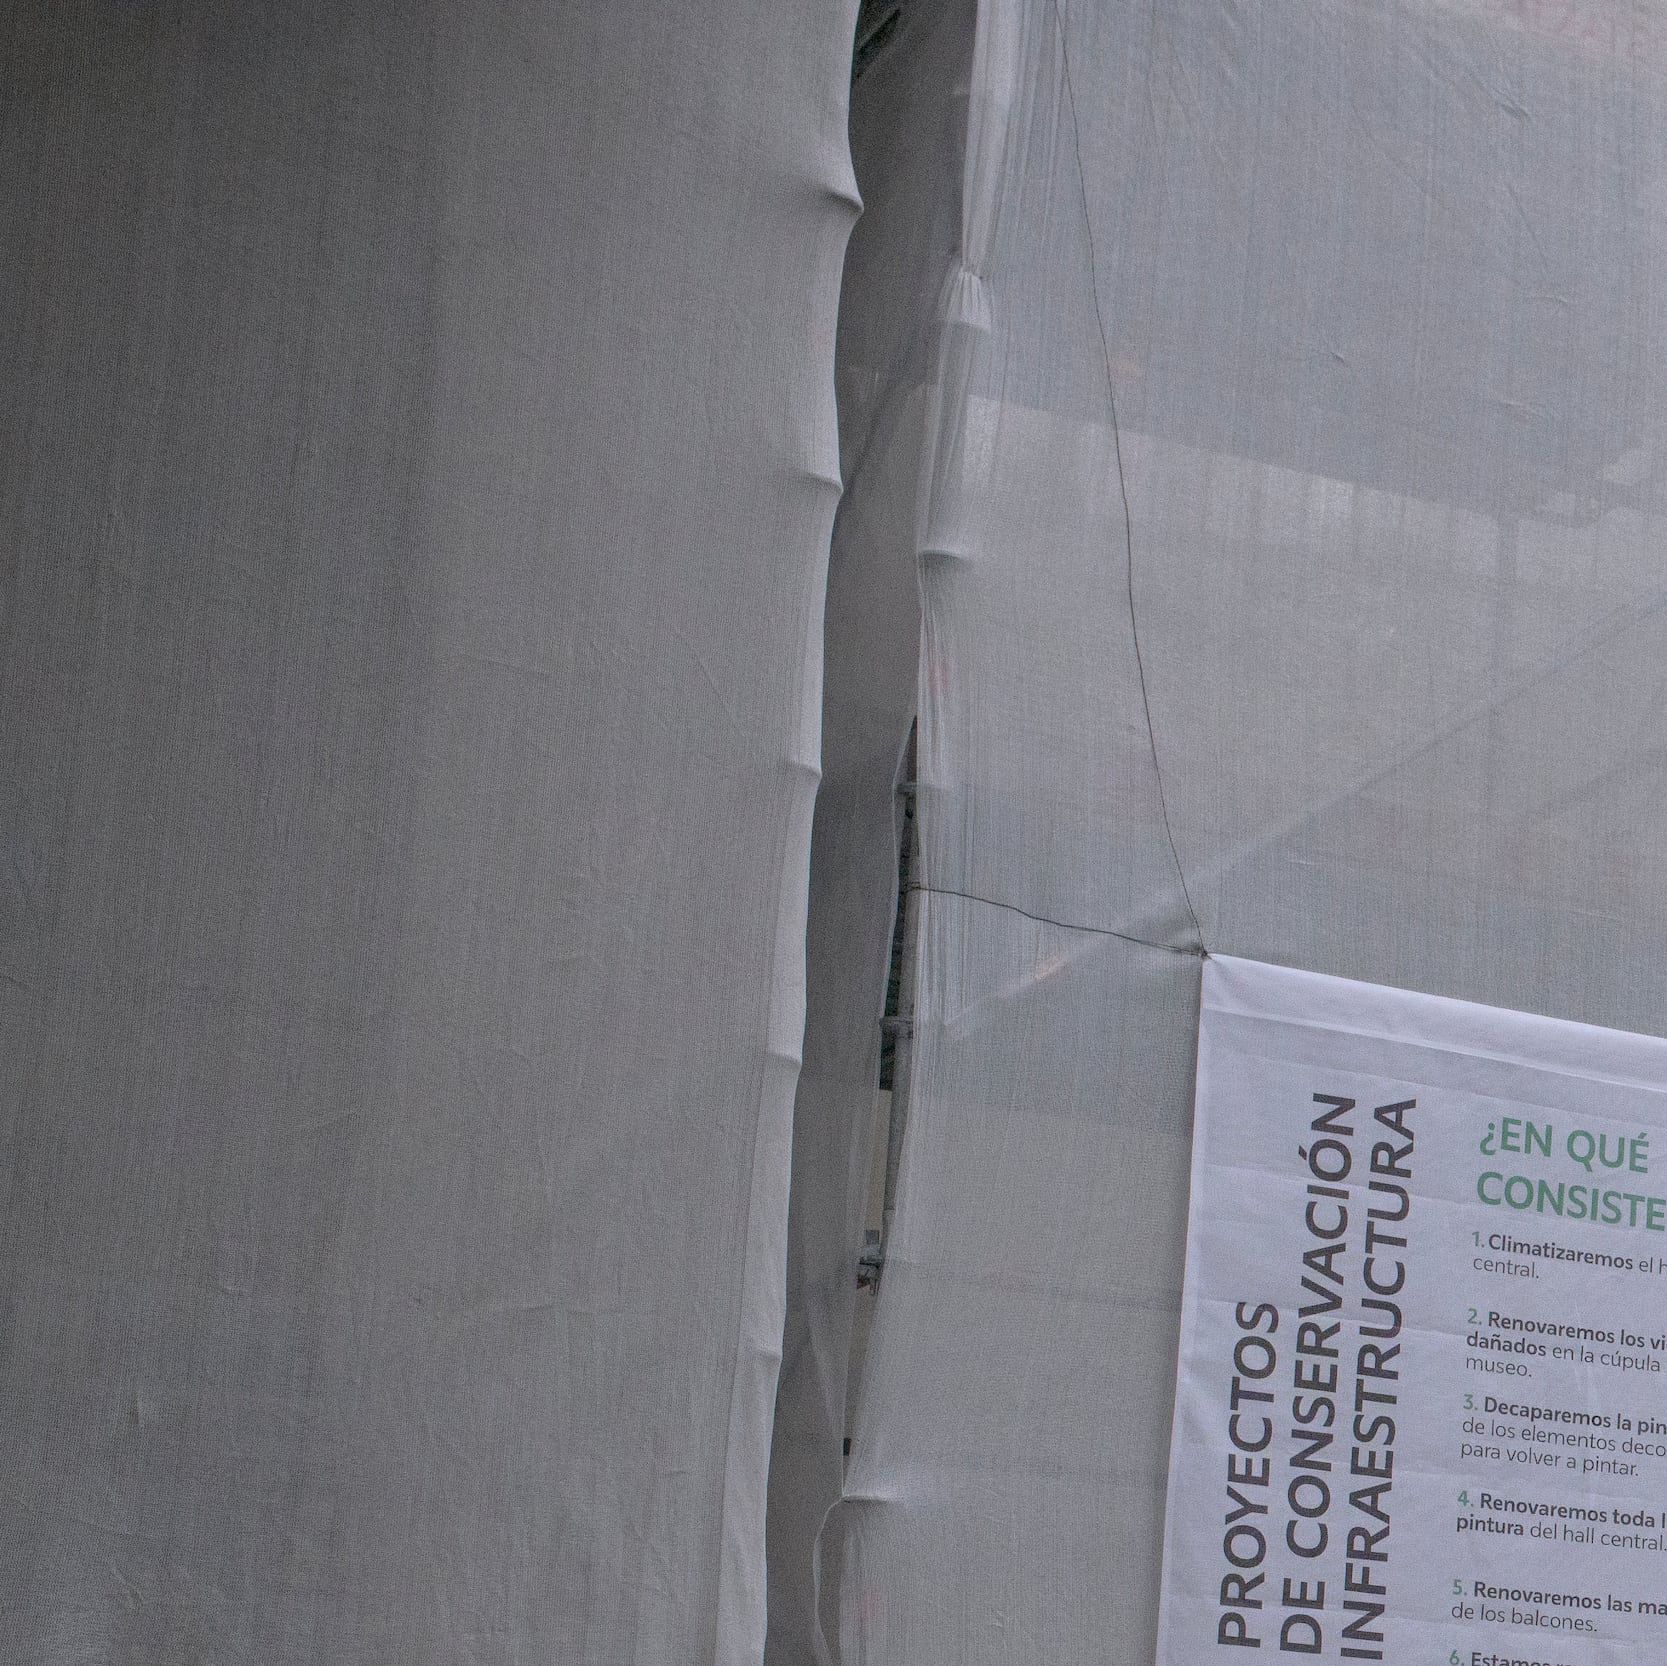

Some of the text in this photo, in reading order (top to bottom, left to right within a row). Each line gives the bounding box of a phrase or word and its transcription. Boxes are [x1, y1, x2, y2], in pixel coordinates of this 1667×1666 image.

[1479, 1116, 1649, 1173] ¿EN QUÉ
[1472, 1232, 1484, 1247] 1.
[1488, 1234, 1633, 1270] Climatizaremos
[1639, 1258, 1652, 1272] el
[1473, 1256, 1540, 1278] central.
[1467, 1308, 1482, 1324] 2.
[1488, 1311, 1614, 1343] Renovaremos
[1620, 1330, 1645, 1348] los
[1466, 1332, 1546, 1356] dañados
[1552, 1346, 1574, 1360] en
[1581, 1346, 1594, 1363] la
[1600, 1350, 1660, 1372] cúpula
[1466, 1357, 1532, 1377] museo.
[1279, 1093, 1356, 1654] DE CONSERVACIÓN
[1341, 1099, 1416, 1660] INFRAESTRUCTURA
[1463, 1395, 1478, 1410] 3.
[1484, 1397, 1611, 1428] Decaparemos
[1616, 1413, 1632, 1431] la
[1462, 1417, 1485, 1434] de
[1491, 1420, 1516, 1438] los
[1521, 1427, 1616, 1451] elementos
[1217, 1301, 1279, 1648] PROYECTOS
[1461, 1442, 1639, 1476] para volver a pintar.
[1457, 1490, 1474, 1507] 4.
[1480, 1493, 1607, 1523] Renovaremos
[1613, 1509, 1655, 1528] toda
[1456, 1514, 1667, 1551] pintura del hall central.
[1452, 1580, 1467, 1596] 5.
[1474, 1581, 1601, 1609] Renovaremos
[1607, 1595, 1632, 1613] las
[1451, 1602, 1598, 1632] de los balcones.
[1449, 1650, 1464, 1666] 6.
